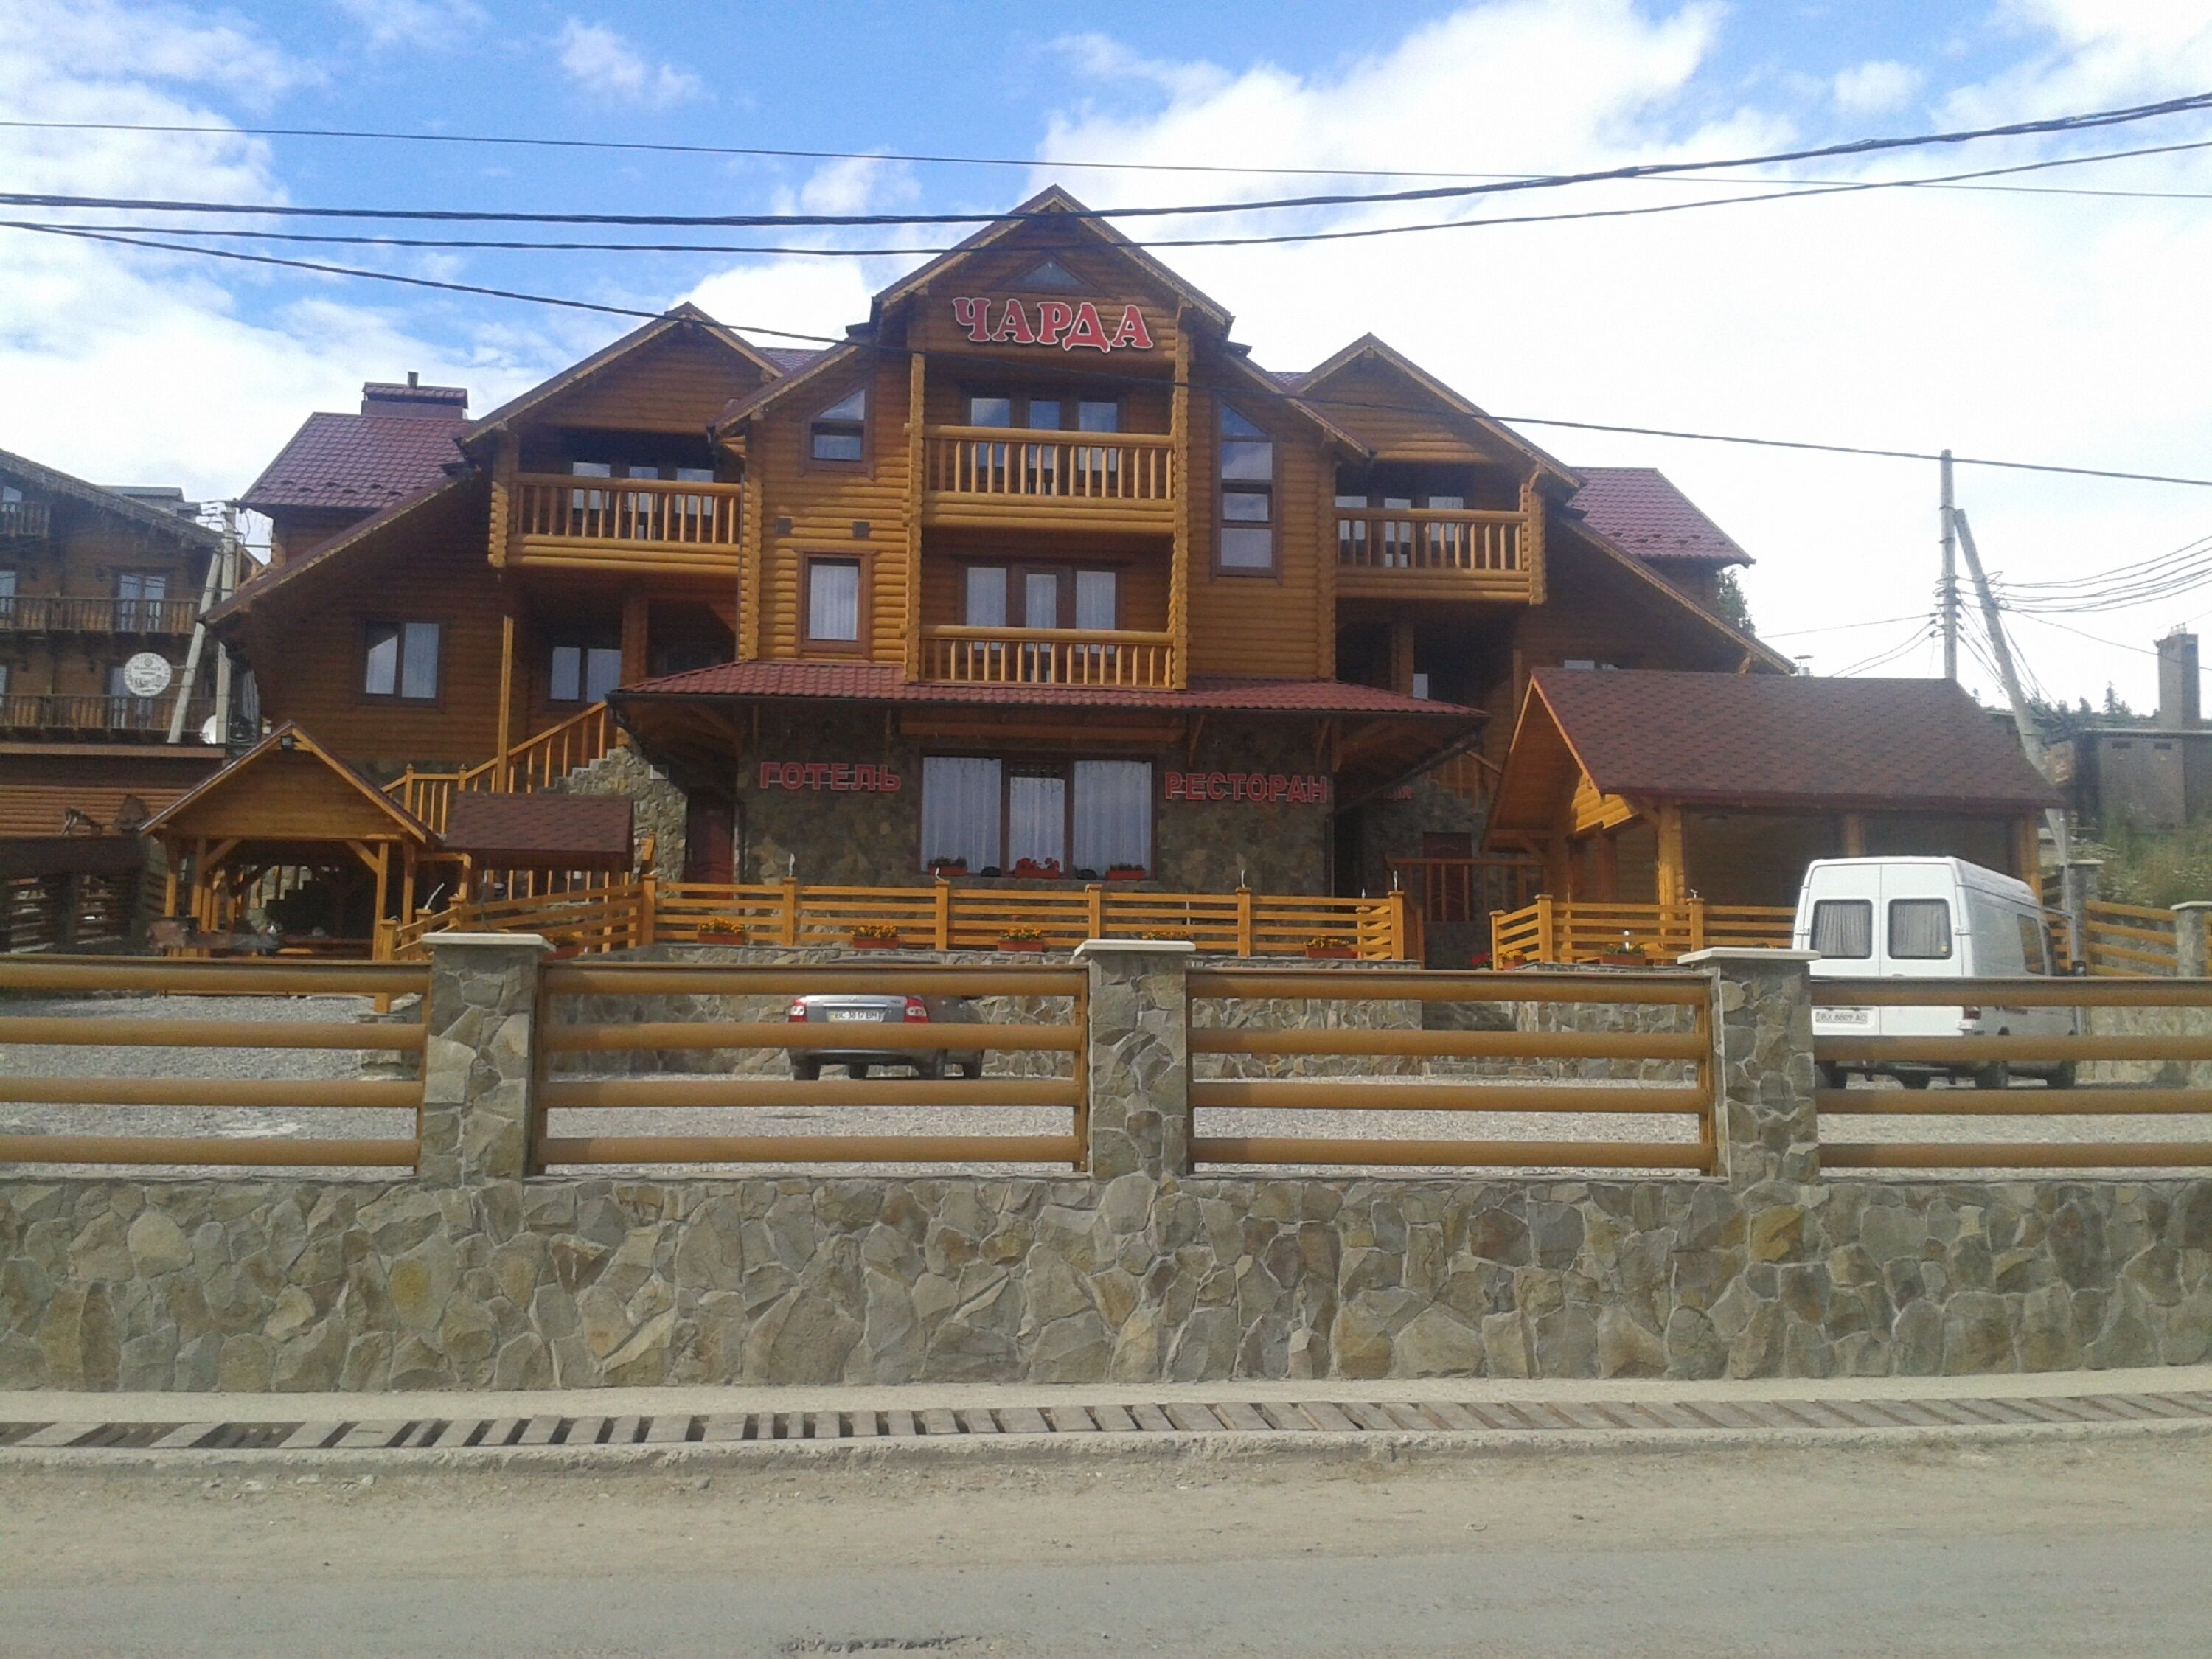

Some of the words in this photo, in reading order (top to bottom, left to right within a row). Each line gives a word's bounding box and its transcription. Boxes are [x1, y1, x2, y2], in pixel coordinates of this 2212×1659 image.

[952, 296, 1153, 353] ЧАРДА
[759, 762, 901, 791] ГОТЕЛЬ
[1165, 772, 1327, 803] РЕСТОРАН
